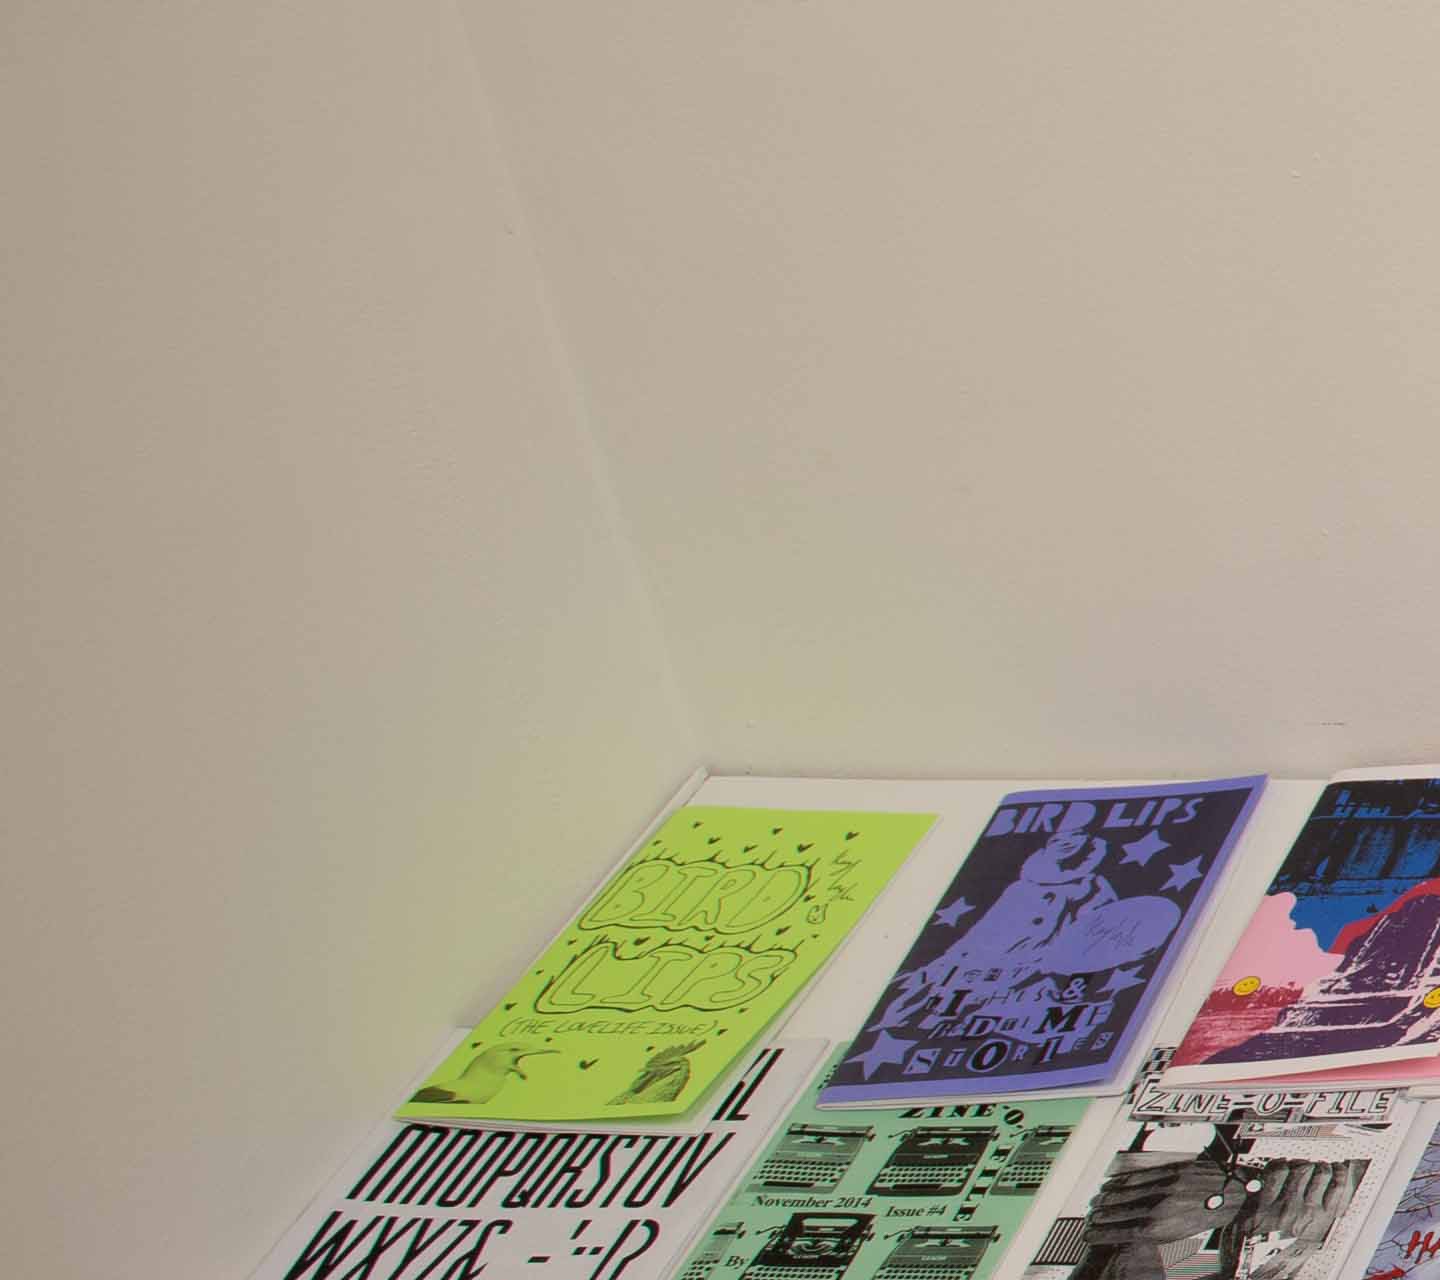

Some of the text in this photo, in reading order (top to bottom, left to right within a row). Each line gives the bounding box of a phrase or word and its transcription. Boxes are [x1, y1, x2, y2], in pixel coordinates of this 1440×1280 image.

[985, 797, 1205, 837] BIRD LIPS
[583, 860, 803, 930] BIRD
[545, 945, 788, 1008] LIPS
[1061, 974, 1088, 1005] &
[902, 1032, 1115, 1075] STORIES
[753, 1194, 873, 1209] November 2014
[886, 1204, 948, 1218] Issue #4
[727, 1254, 750, 1270] By
